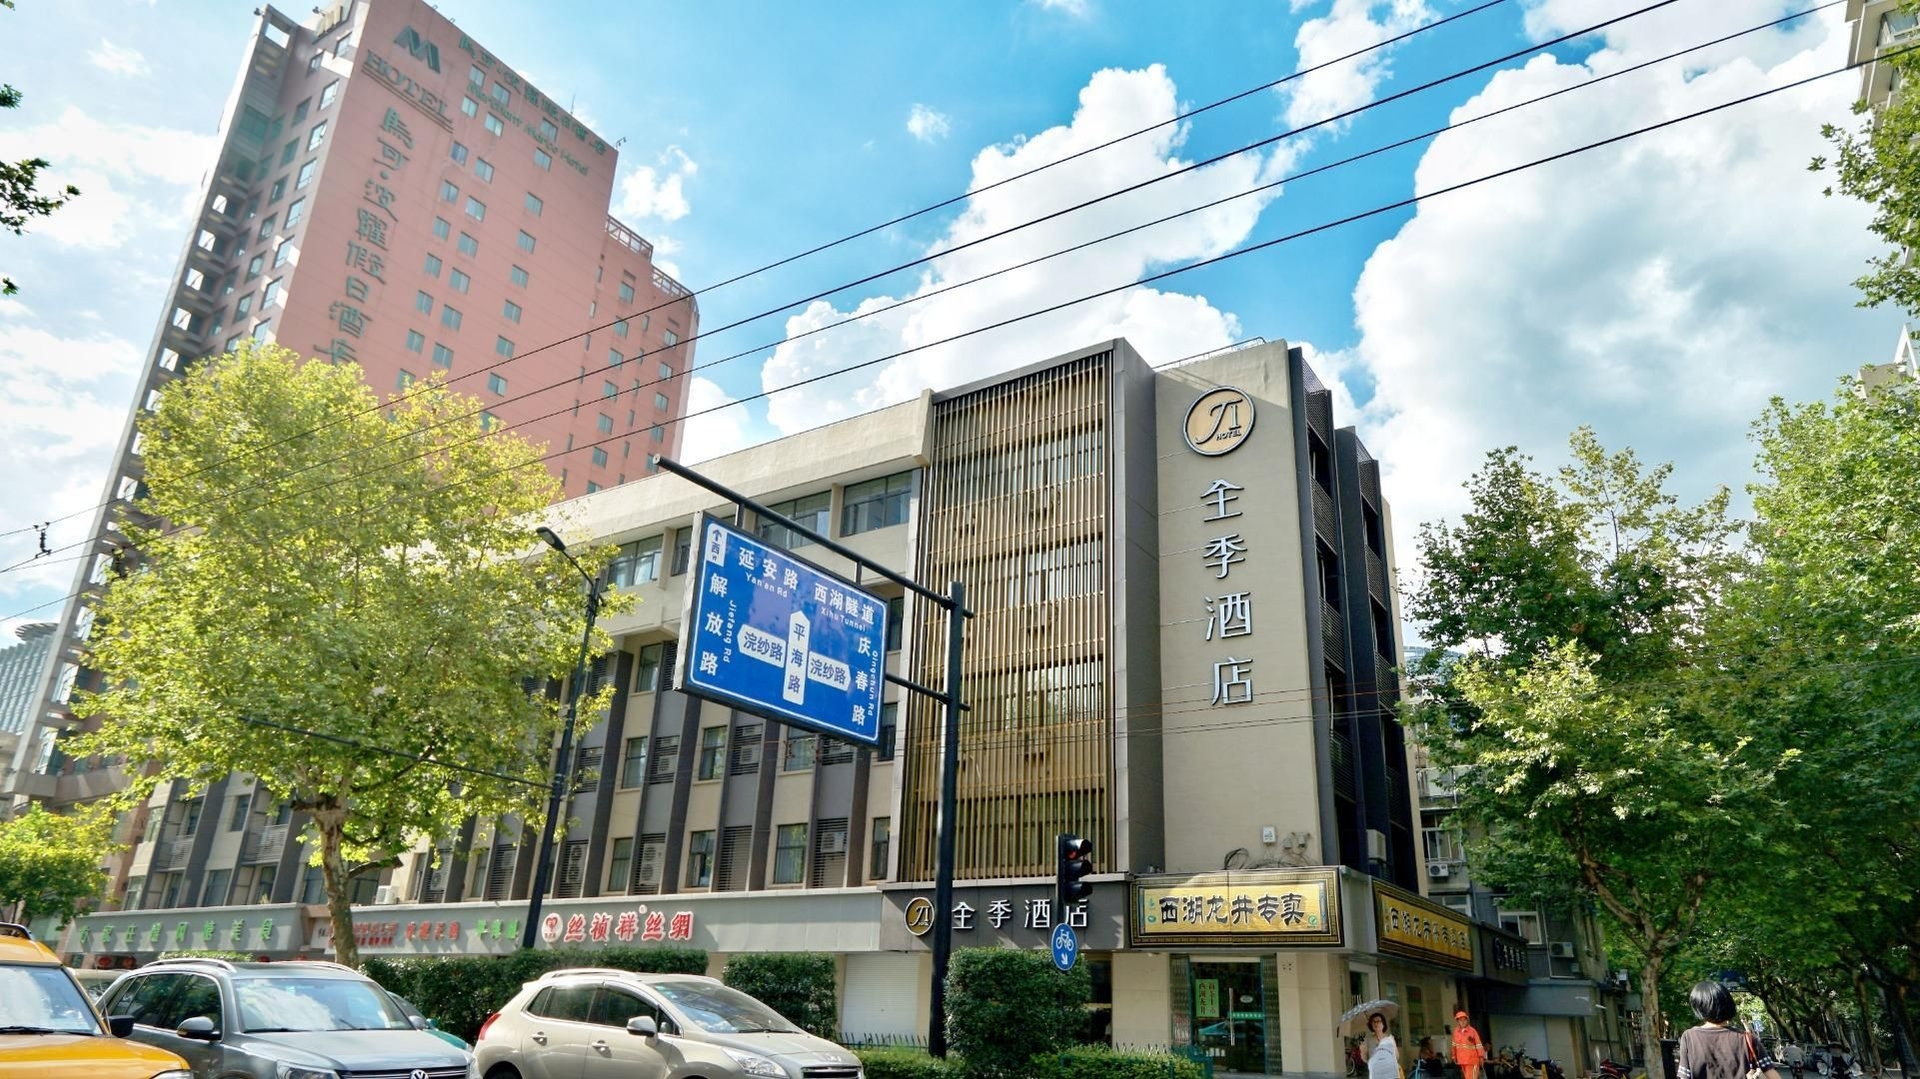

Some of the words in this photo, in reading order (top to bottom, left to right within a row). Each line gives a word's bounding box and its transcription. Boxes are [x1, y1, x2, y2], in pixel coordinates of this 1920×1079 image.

[362, 49, 449, 115] HOTEL
[1215, 429, 1242, 442] HOTEL
[738, 546, 799, 591] 延安路
[777, 585, 788, 598] Rd
[814, 582, 875, 625] 西湖隧道
[1200, 478, 1253, 706] 全季酒店
[699, 573, 728, 676] 解放路
[723, 599, 737, 645] Jiefang
[820, 607, 839, 622] Xihu
[840, 616, 867, 632] Tunnel
[723, 648, 732, 664] Rd
[743, 631, 784, 662] 浣纱路
[787, 622, 806, 694] 平海路
[810, 658, 846, 686] 浣纱路
[852, 636, 872, 726] 庆春路
[867, 702, 875, 717] Rd
[952, 899, 1089, 930] 全季酒店
[1158, 893, 1305, 926] 西湖龙井专卖
